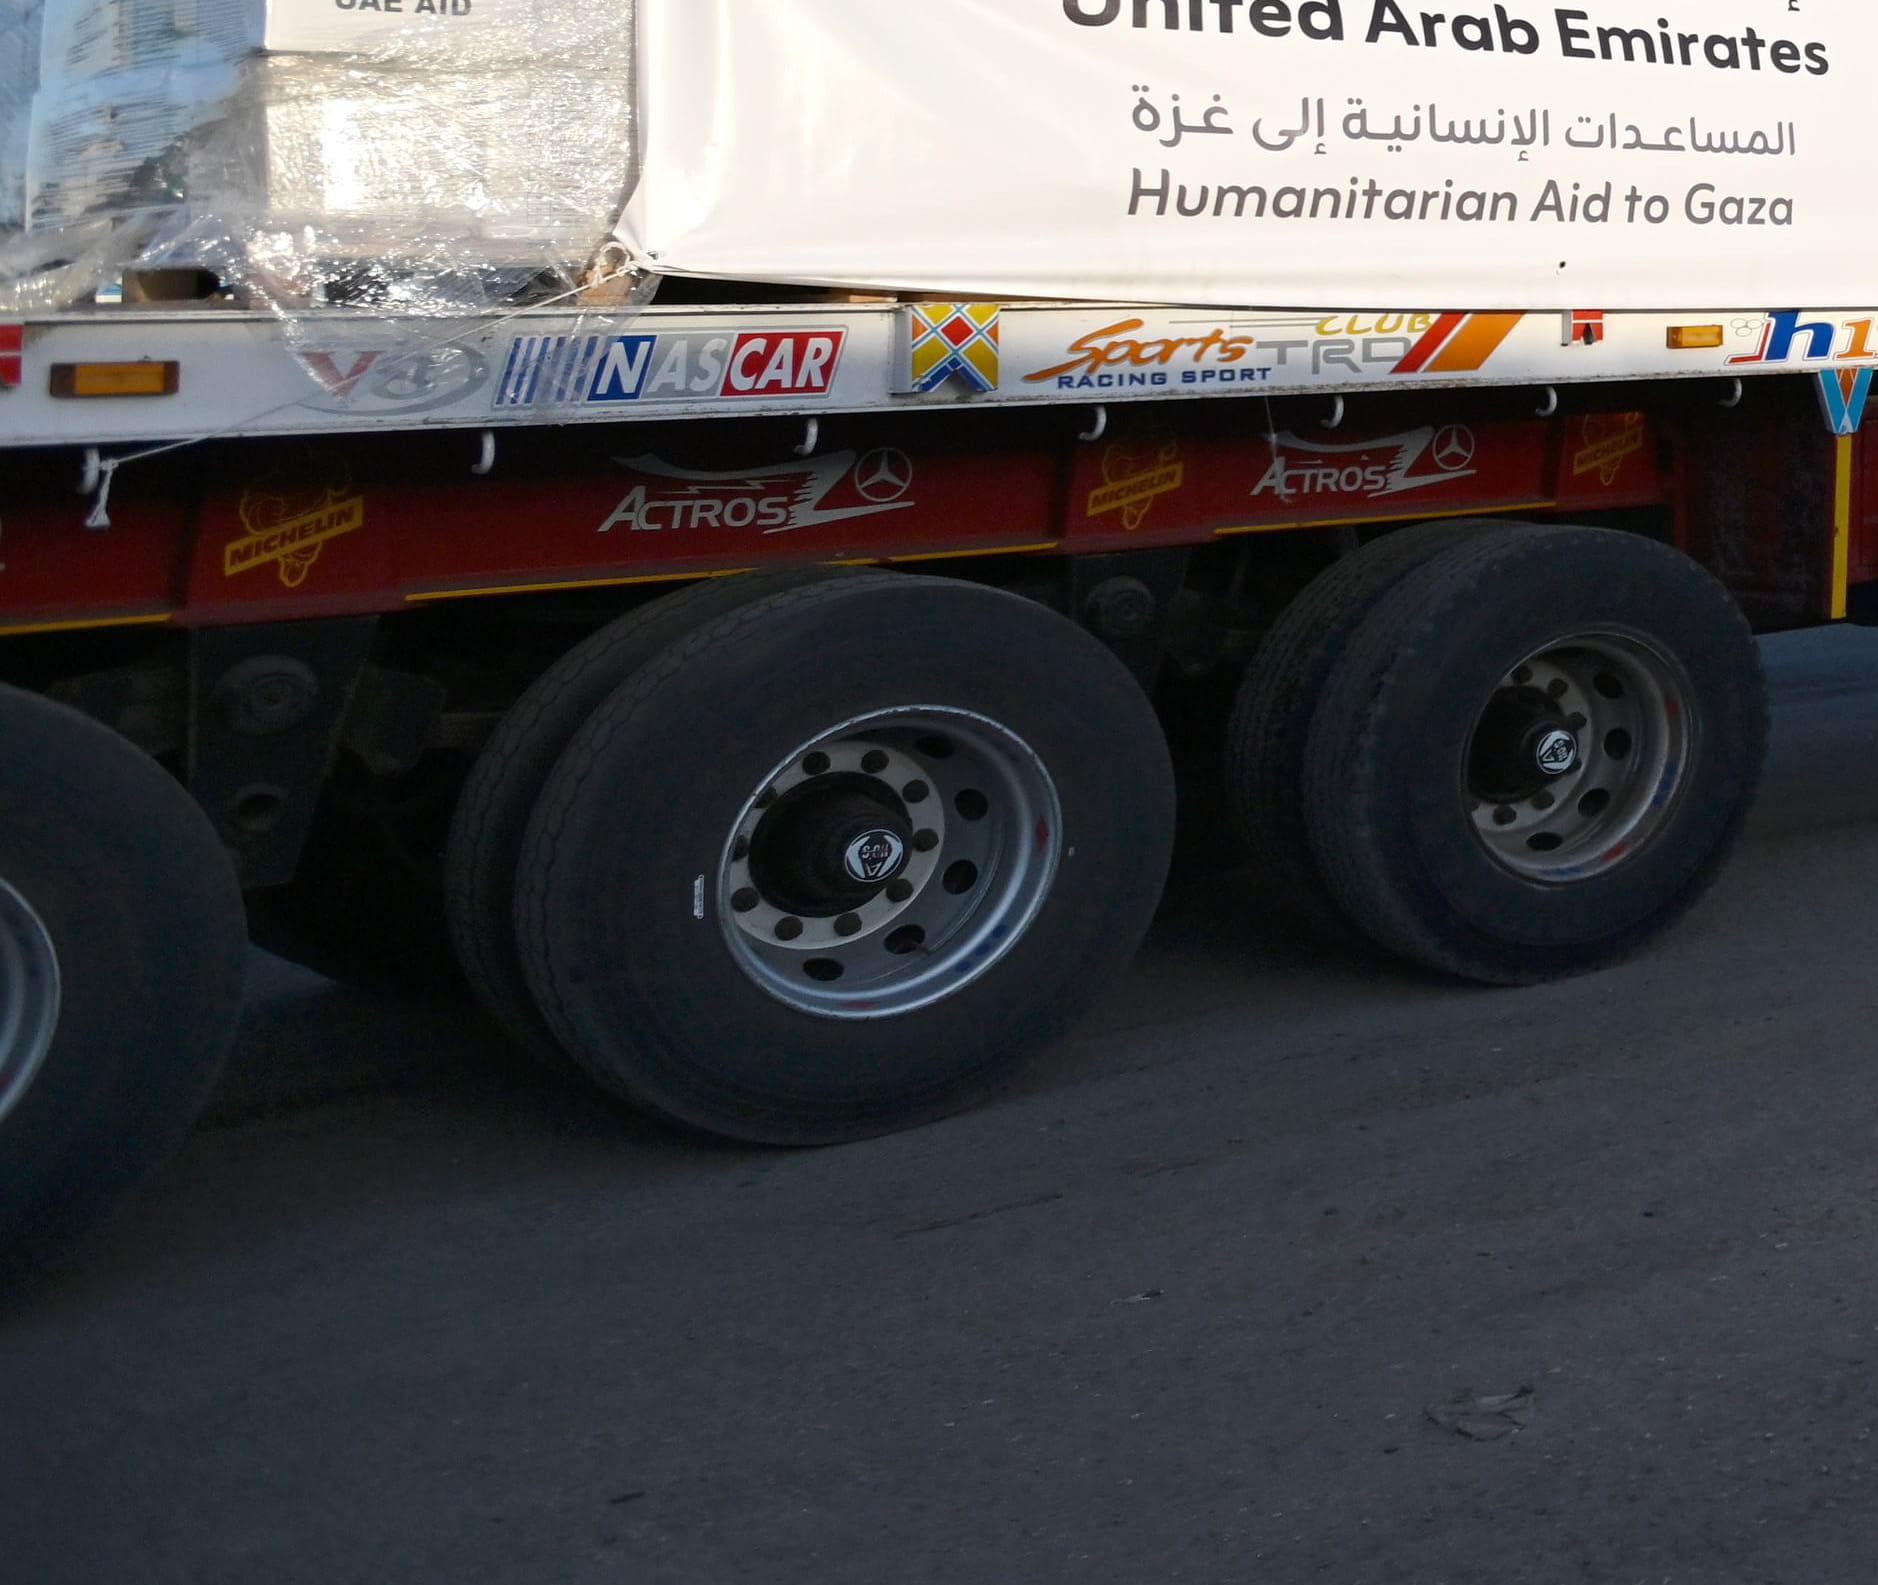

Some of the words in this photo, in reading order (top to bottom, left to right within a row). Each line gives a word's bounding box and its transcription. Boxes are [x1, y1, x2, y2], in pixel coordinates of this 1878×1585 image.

[1560, 10, 1829, 75] Emirates
[1133, 85, 1231, 153] غزة
[1253, 97, 1328, 153] إلى
[1344, 96, 1550, 162] الإنسانية
[1566, 113, 1797, 156] المساعدات
[1126, 167, 1519, 225] Humanitarian
[1530, 178, 1614, 225] Aid
[1625, 186, 1670, 225] to
[1683, 184, 1794, 227] Gaza
[1022, 318, 1254, 380] Sports
[1315, 313, 1435, 335] CLUB
[593, 336, 832, 396] NASCAR
[1058, 371, 1168, 389] RACING
[1182, 367, 1272, 382] SPORT
[1090, 468, 1177, 513] MICHELIN
[230, 506, 350, 565] MICHELIN
